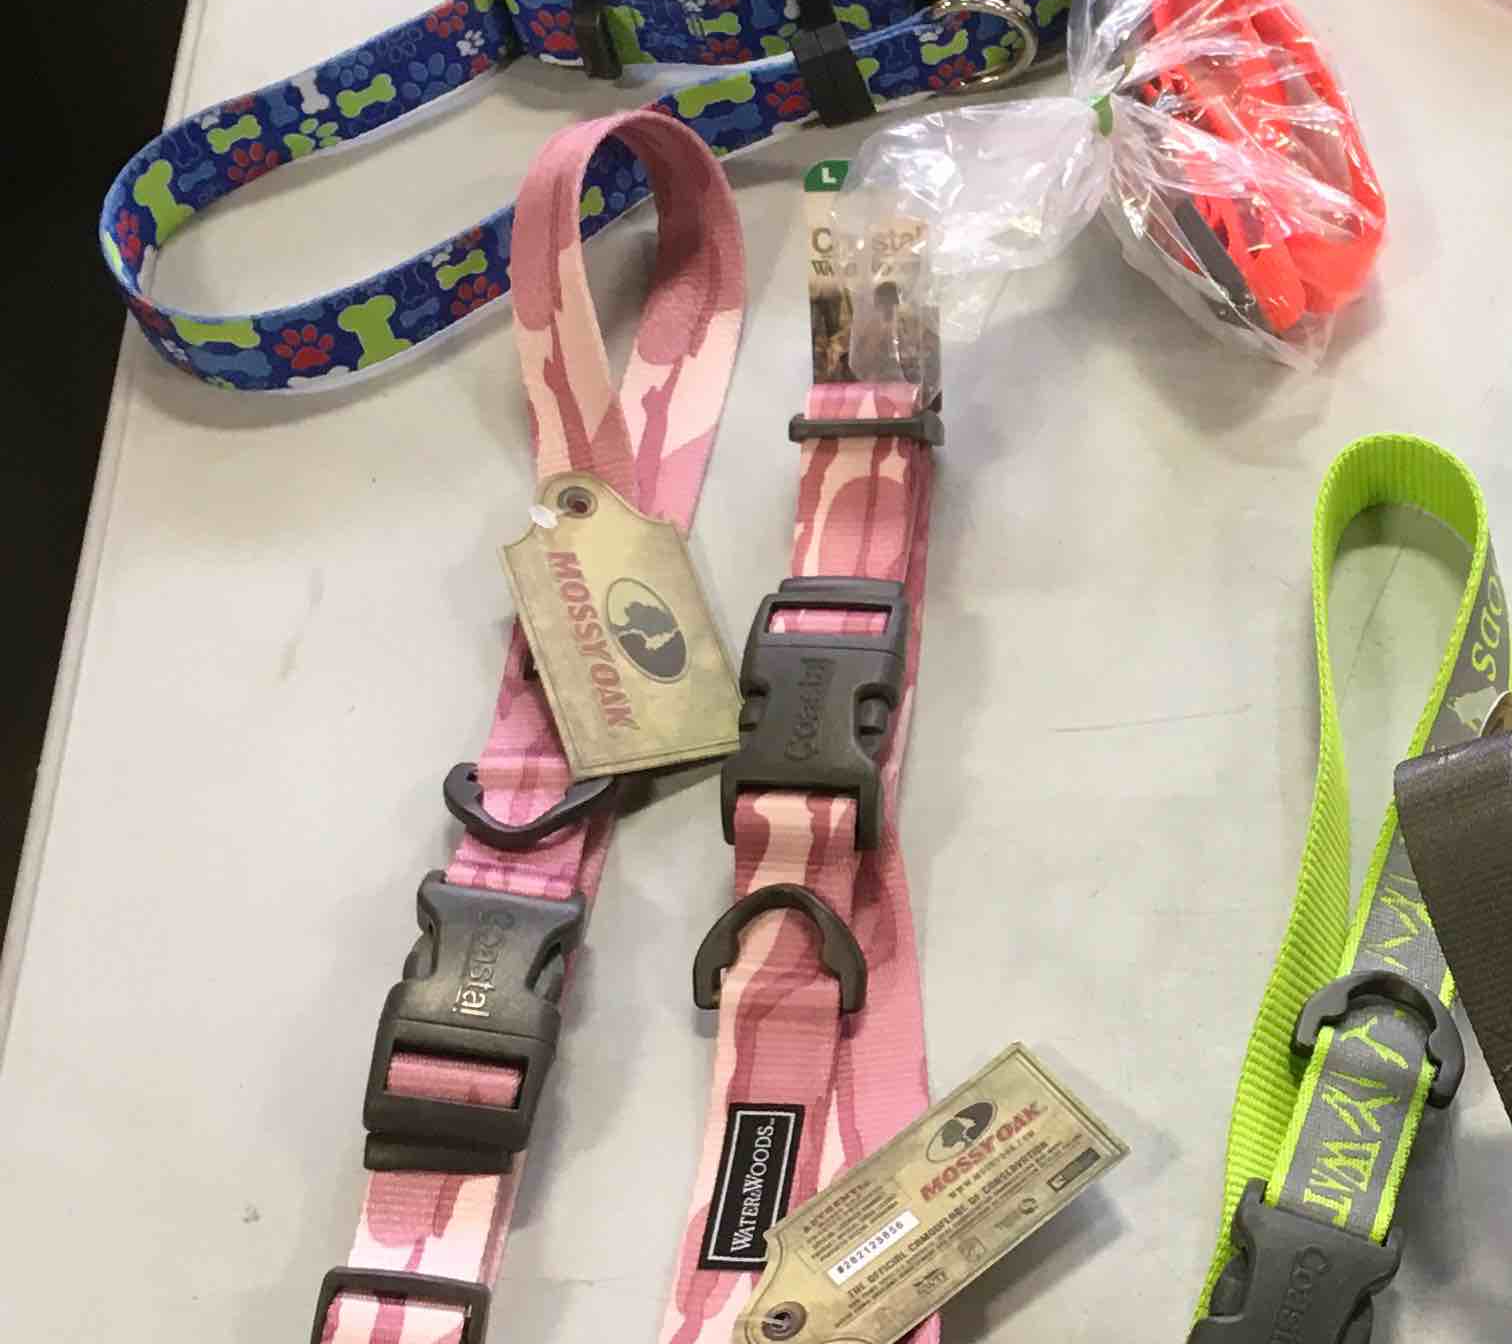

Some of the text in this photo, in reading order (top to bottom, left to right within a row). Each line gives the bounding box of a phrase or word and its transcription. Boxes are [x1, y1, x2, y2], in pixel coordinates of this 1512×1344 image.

[821, 167, 837, 184] L
[547, 551, 640, 731] MOSSY OAK
[916, 1132, 1000, 1203] MOSSY
[991, 1100, 1043, 1146] OAK
